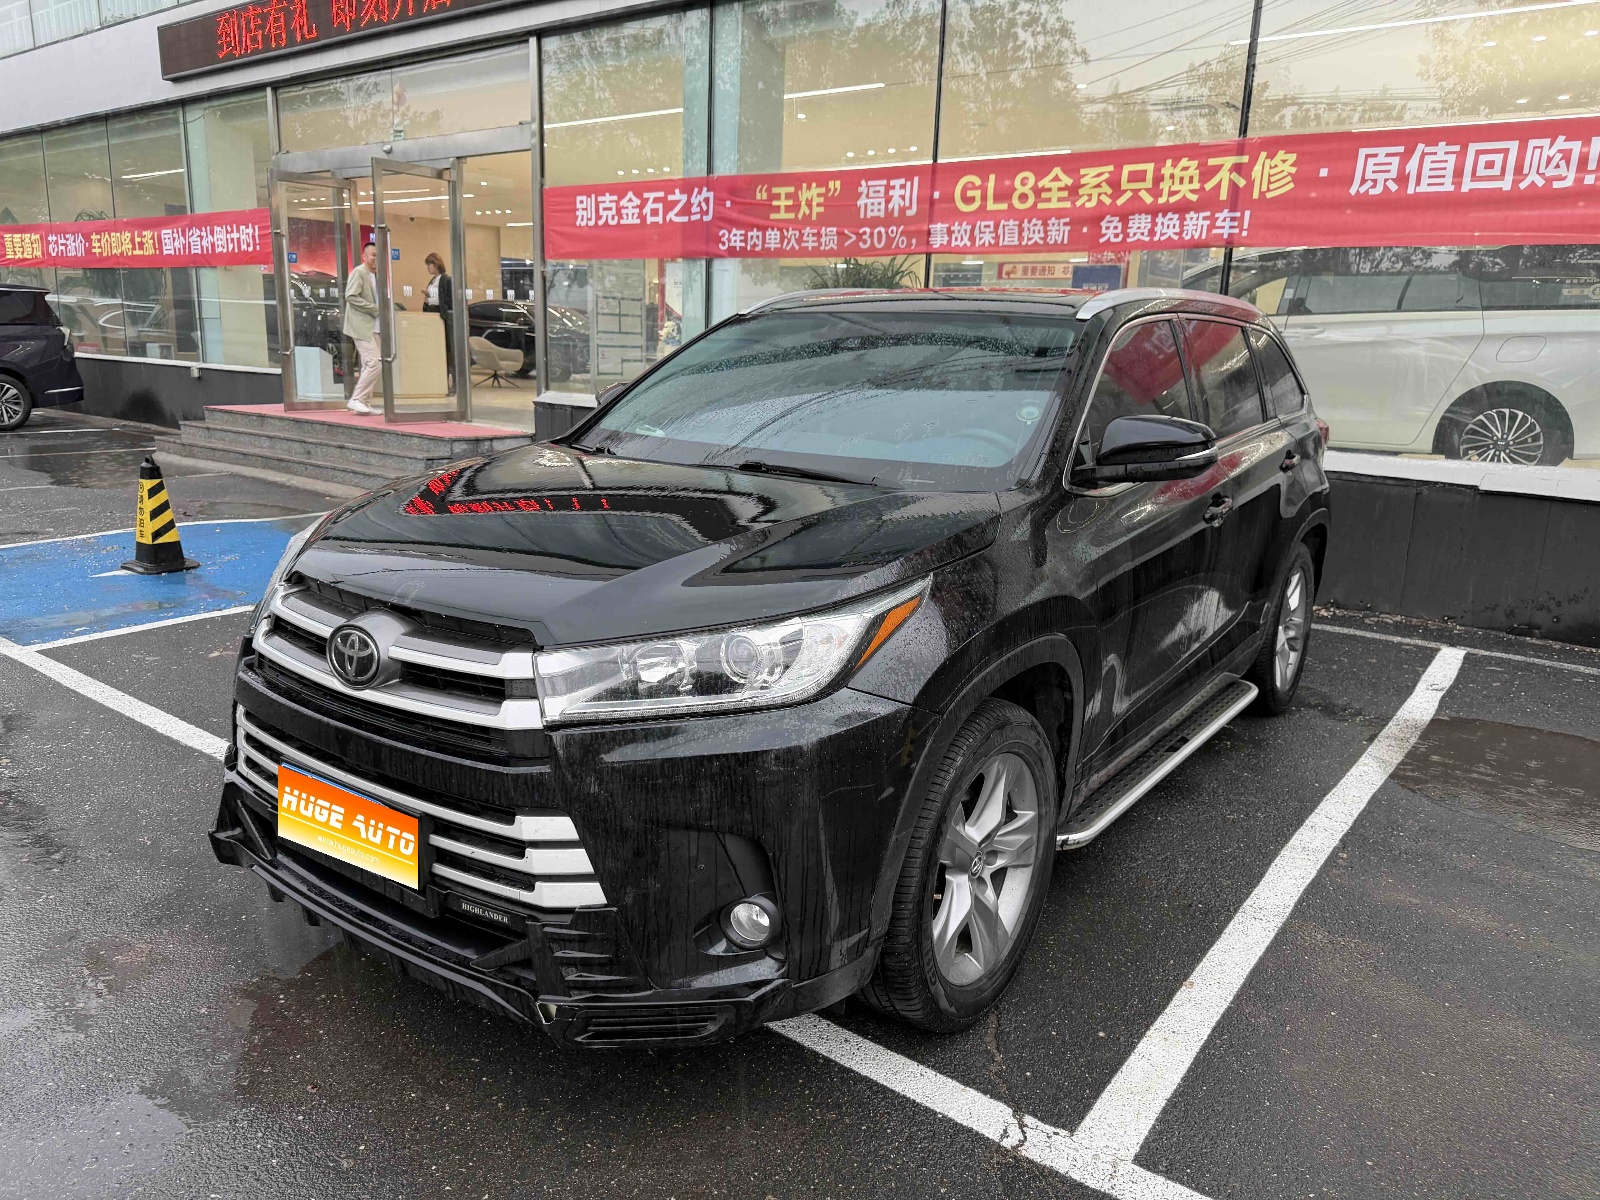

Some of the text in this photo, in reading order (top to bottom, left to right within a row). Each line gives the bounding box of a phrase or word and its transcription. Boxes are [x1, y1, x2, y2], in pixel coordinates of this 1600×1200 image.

[216, 0, 451, 58] 到店有礼 即刻
[575, 186, 714, 227] 别克金石之约
[857, 176, 919, 219] 福利
[954, 150, 1298, 213] GL8全系只换不修
[3, 233, 43, 260] 重要通知
[1020, 265, 1056, 277] 重要通知
[462, 902, 509, 924] HIGHLANDER
